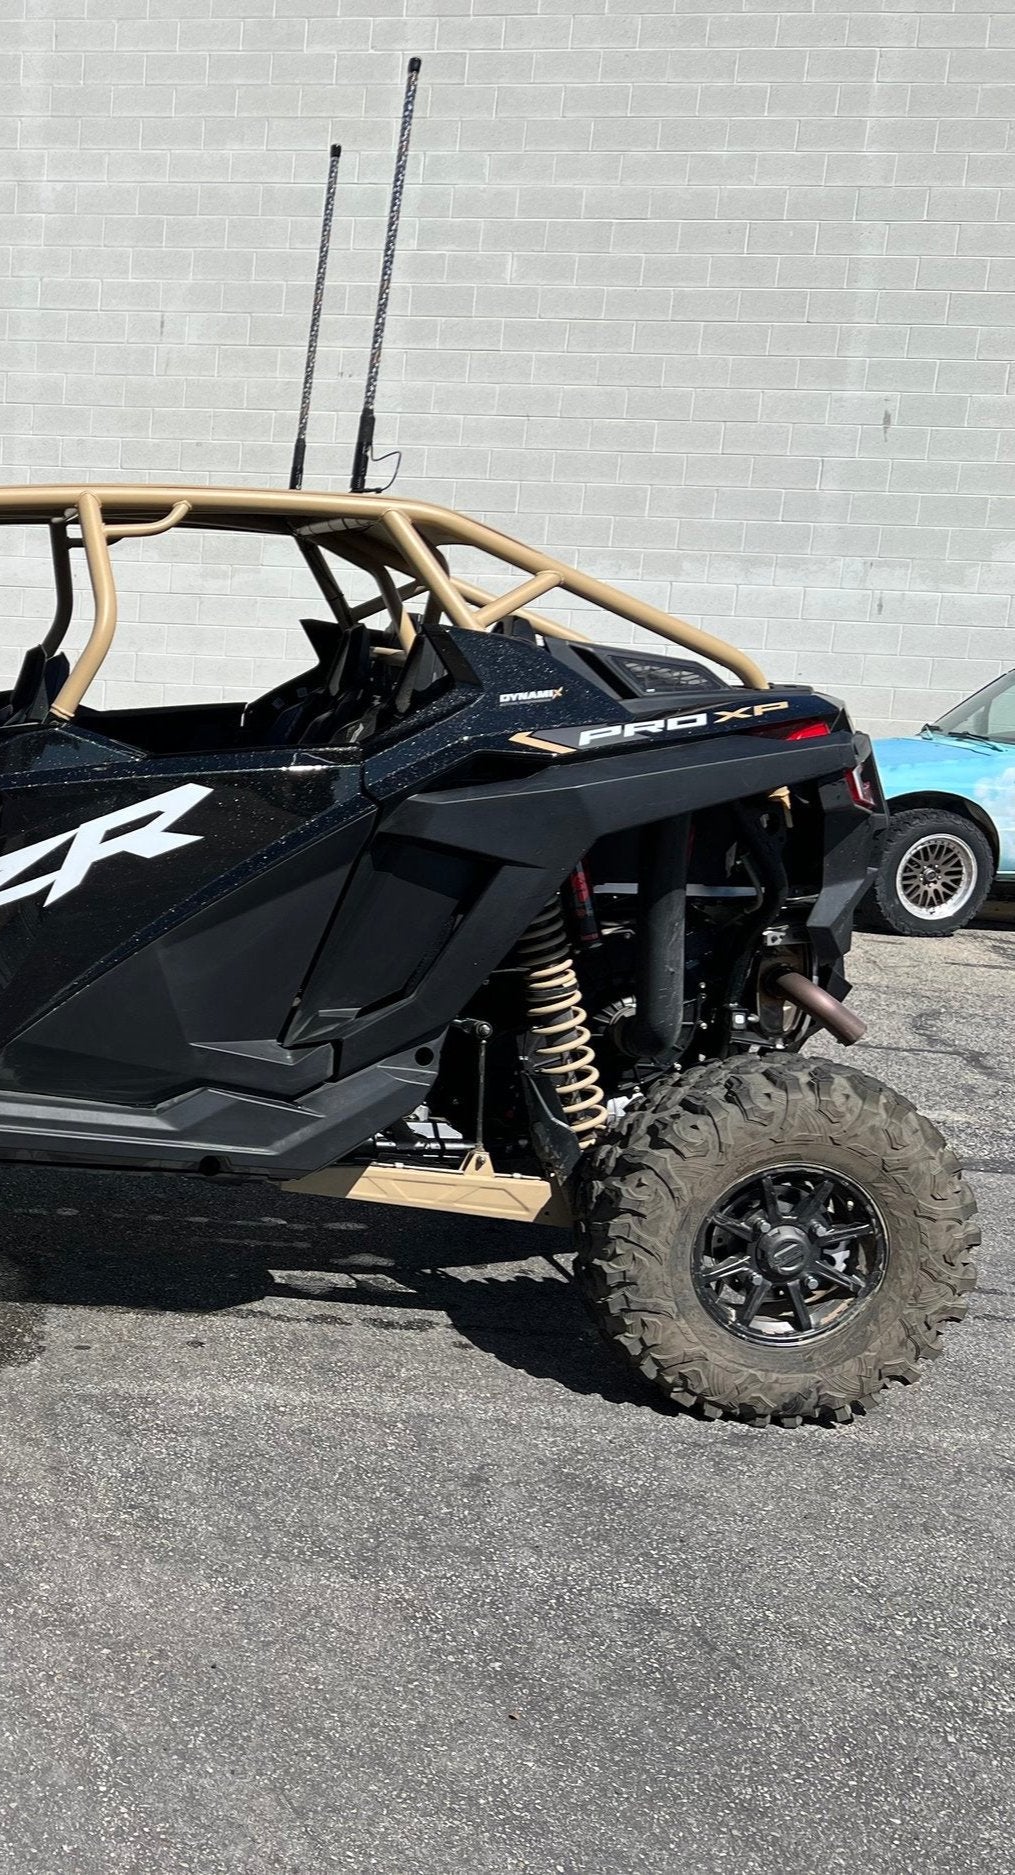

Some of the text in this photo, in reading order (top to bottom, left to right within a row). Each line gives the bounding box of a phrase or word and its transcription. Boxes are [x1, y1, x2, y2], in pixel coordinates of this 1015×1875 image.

[499, 686, 564, 703] DYNAMIX
[578, 701, 789, 747] PRO XP
